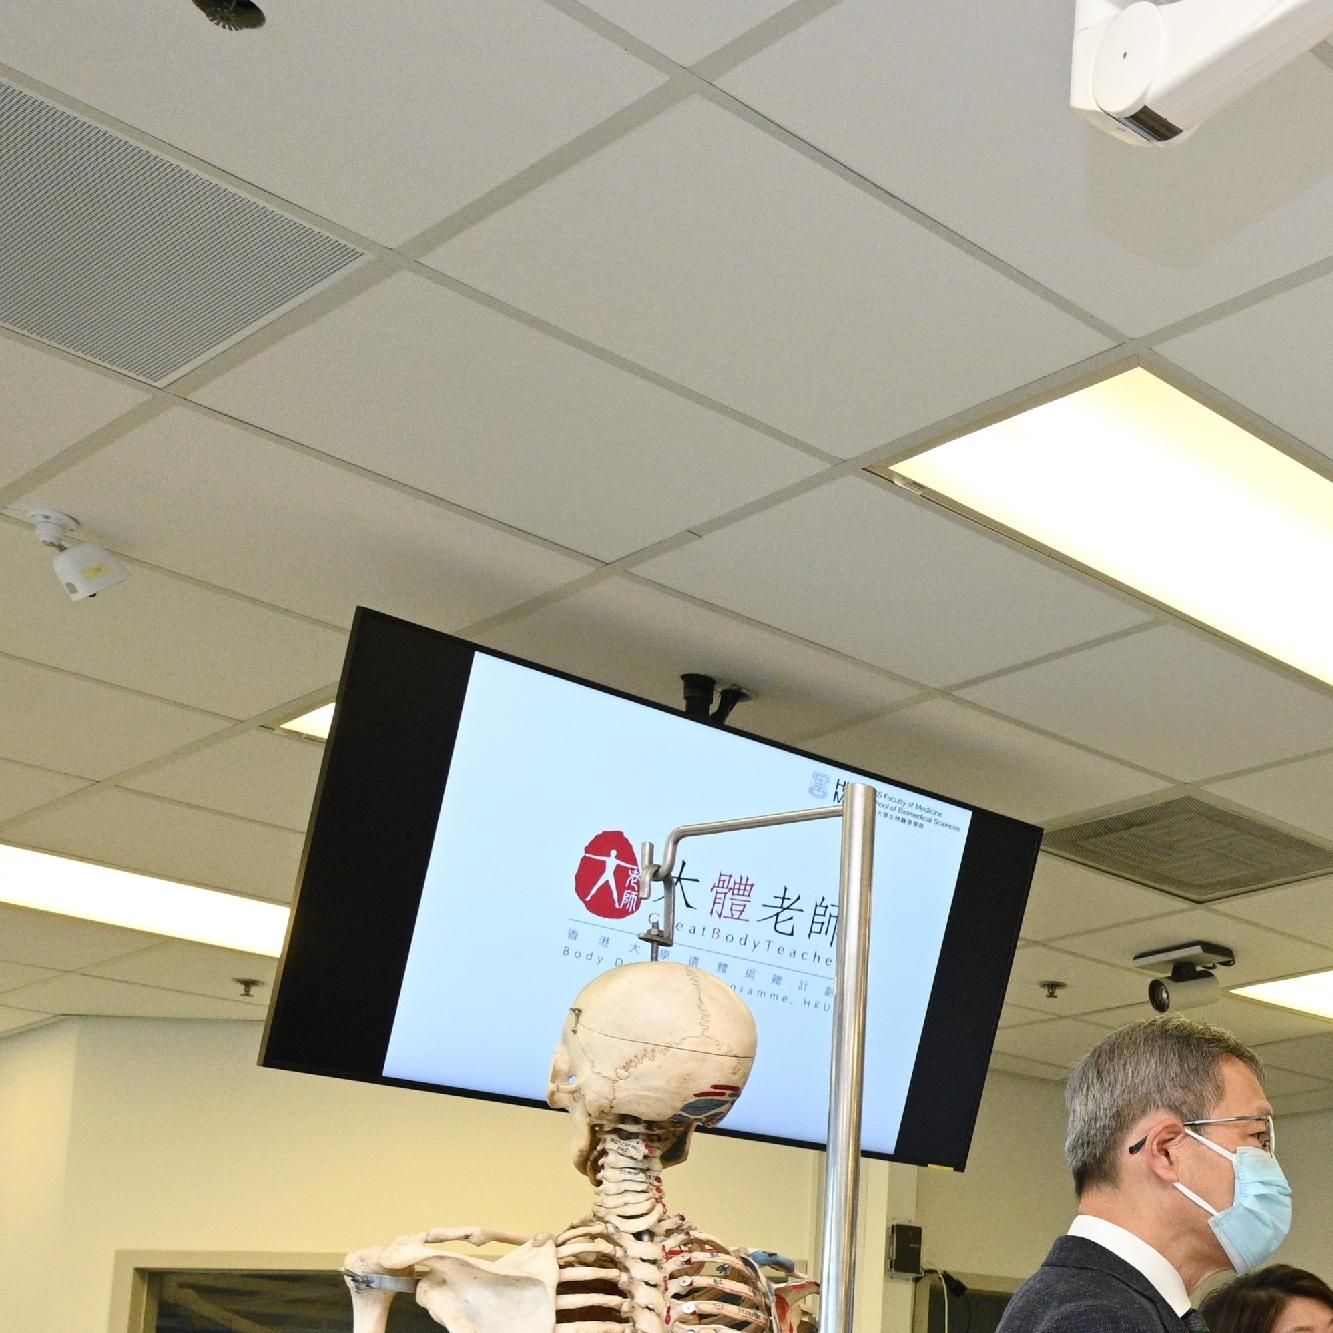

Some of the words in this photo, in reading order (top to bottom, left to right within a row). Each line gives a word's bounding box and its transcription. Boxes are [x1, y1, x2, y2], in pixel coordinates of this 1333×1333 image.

[883, 793, 906, 808] Faculty
[914, 801, 943, 817] Medicine
[897, 807, 933, 824] Biomedical
[933, 817, 961, 832] Sciences
[652, 860, 839, 947] 大體老師
[562, 946, 603, 965] Body
